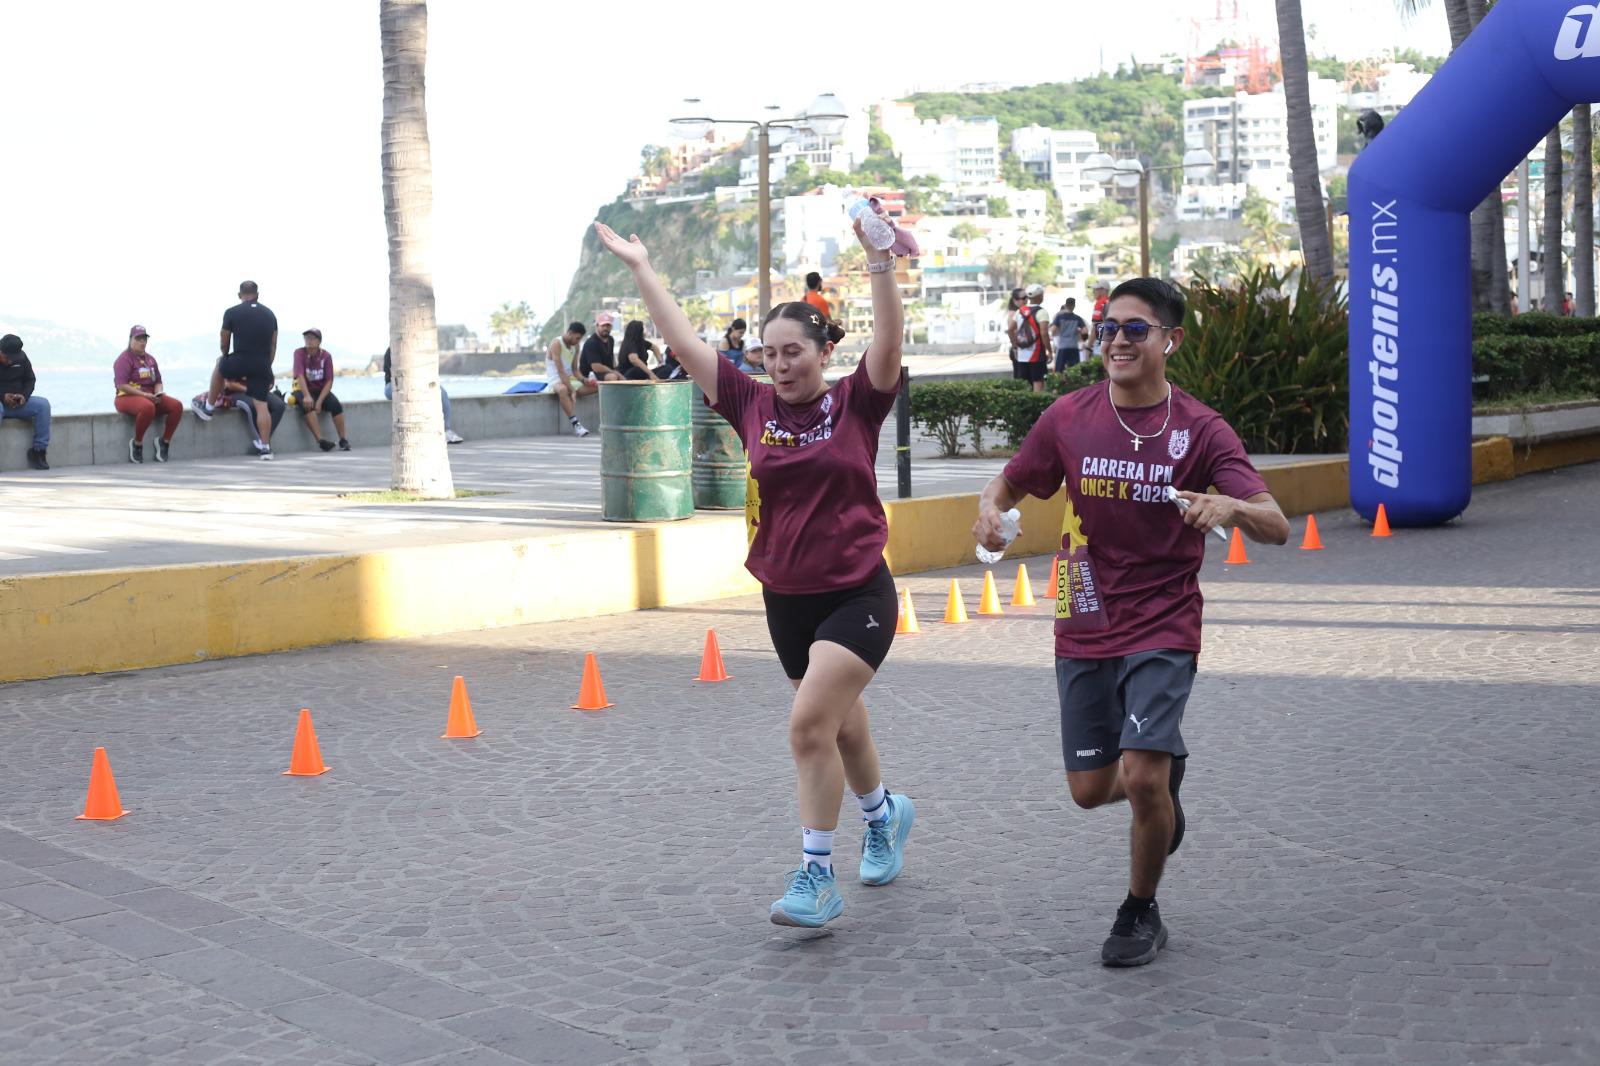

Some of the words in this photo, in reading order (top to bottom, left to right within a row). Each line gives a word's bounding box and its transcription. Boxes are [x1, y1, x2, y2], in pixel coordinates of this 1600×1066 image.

[1368, 199, 1403, 489] dportenis.mx
[787, 435, 795, 446] K
[799, 426, 833, 447] 2026
[1081, 456, 1144, 481] CARRERA
[1148, 463, 1174, 483] IPN
[1080, 477, 1114, 498] ONCE
[1119, 481, 1129, 500] K
[1072, 562, 1082, 584] ONCE
[1058, 565, 1066, 613] 0003
[1079, 561, 1095, 597] CARRERA
[1087, 597, 1100, 612] IPN
[1075, 592, 1089, 613] 2026
[1076, 748, 1096, 758] PUMA
